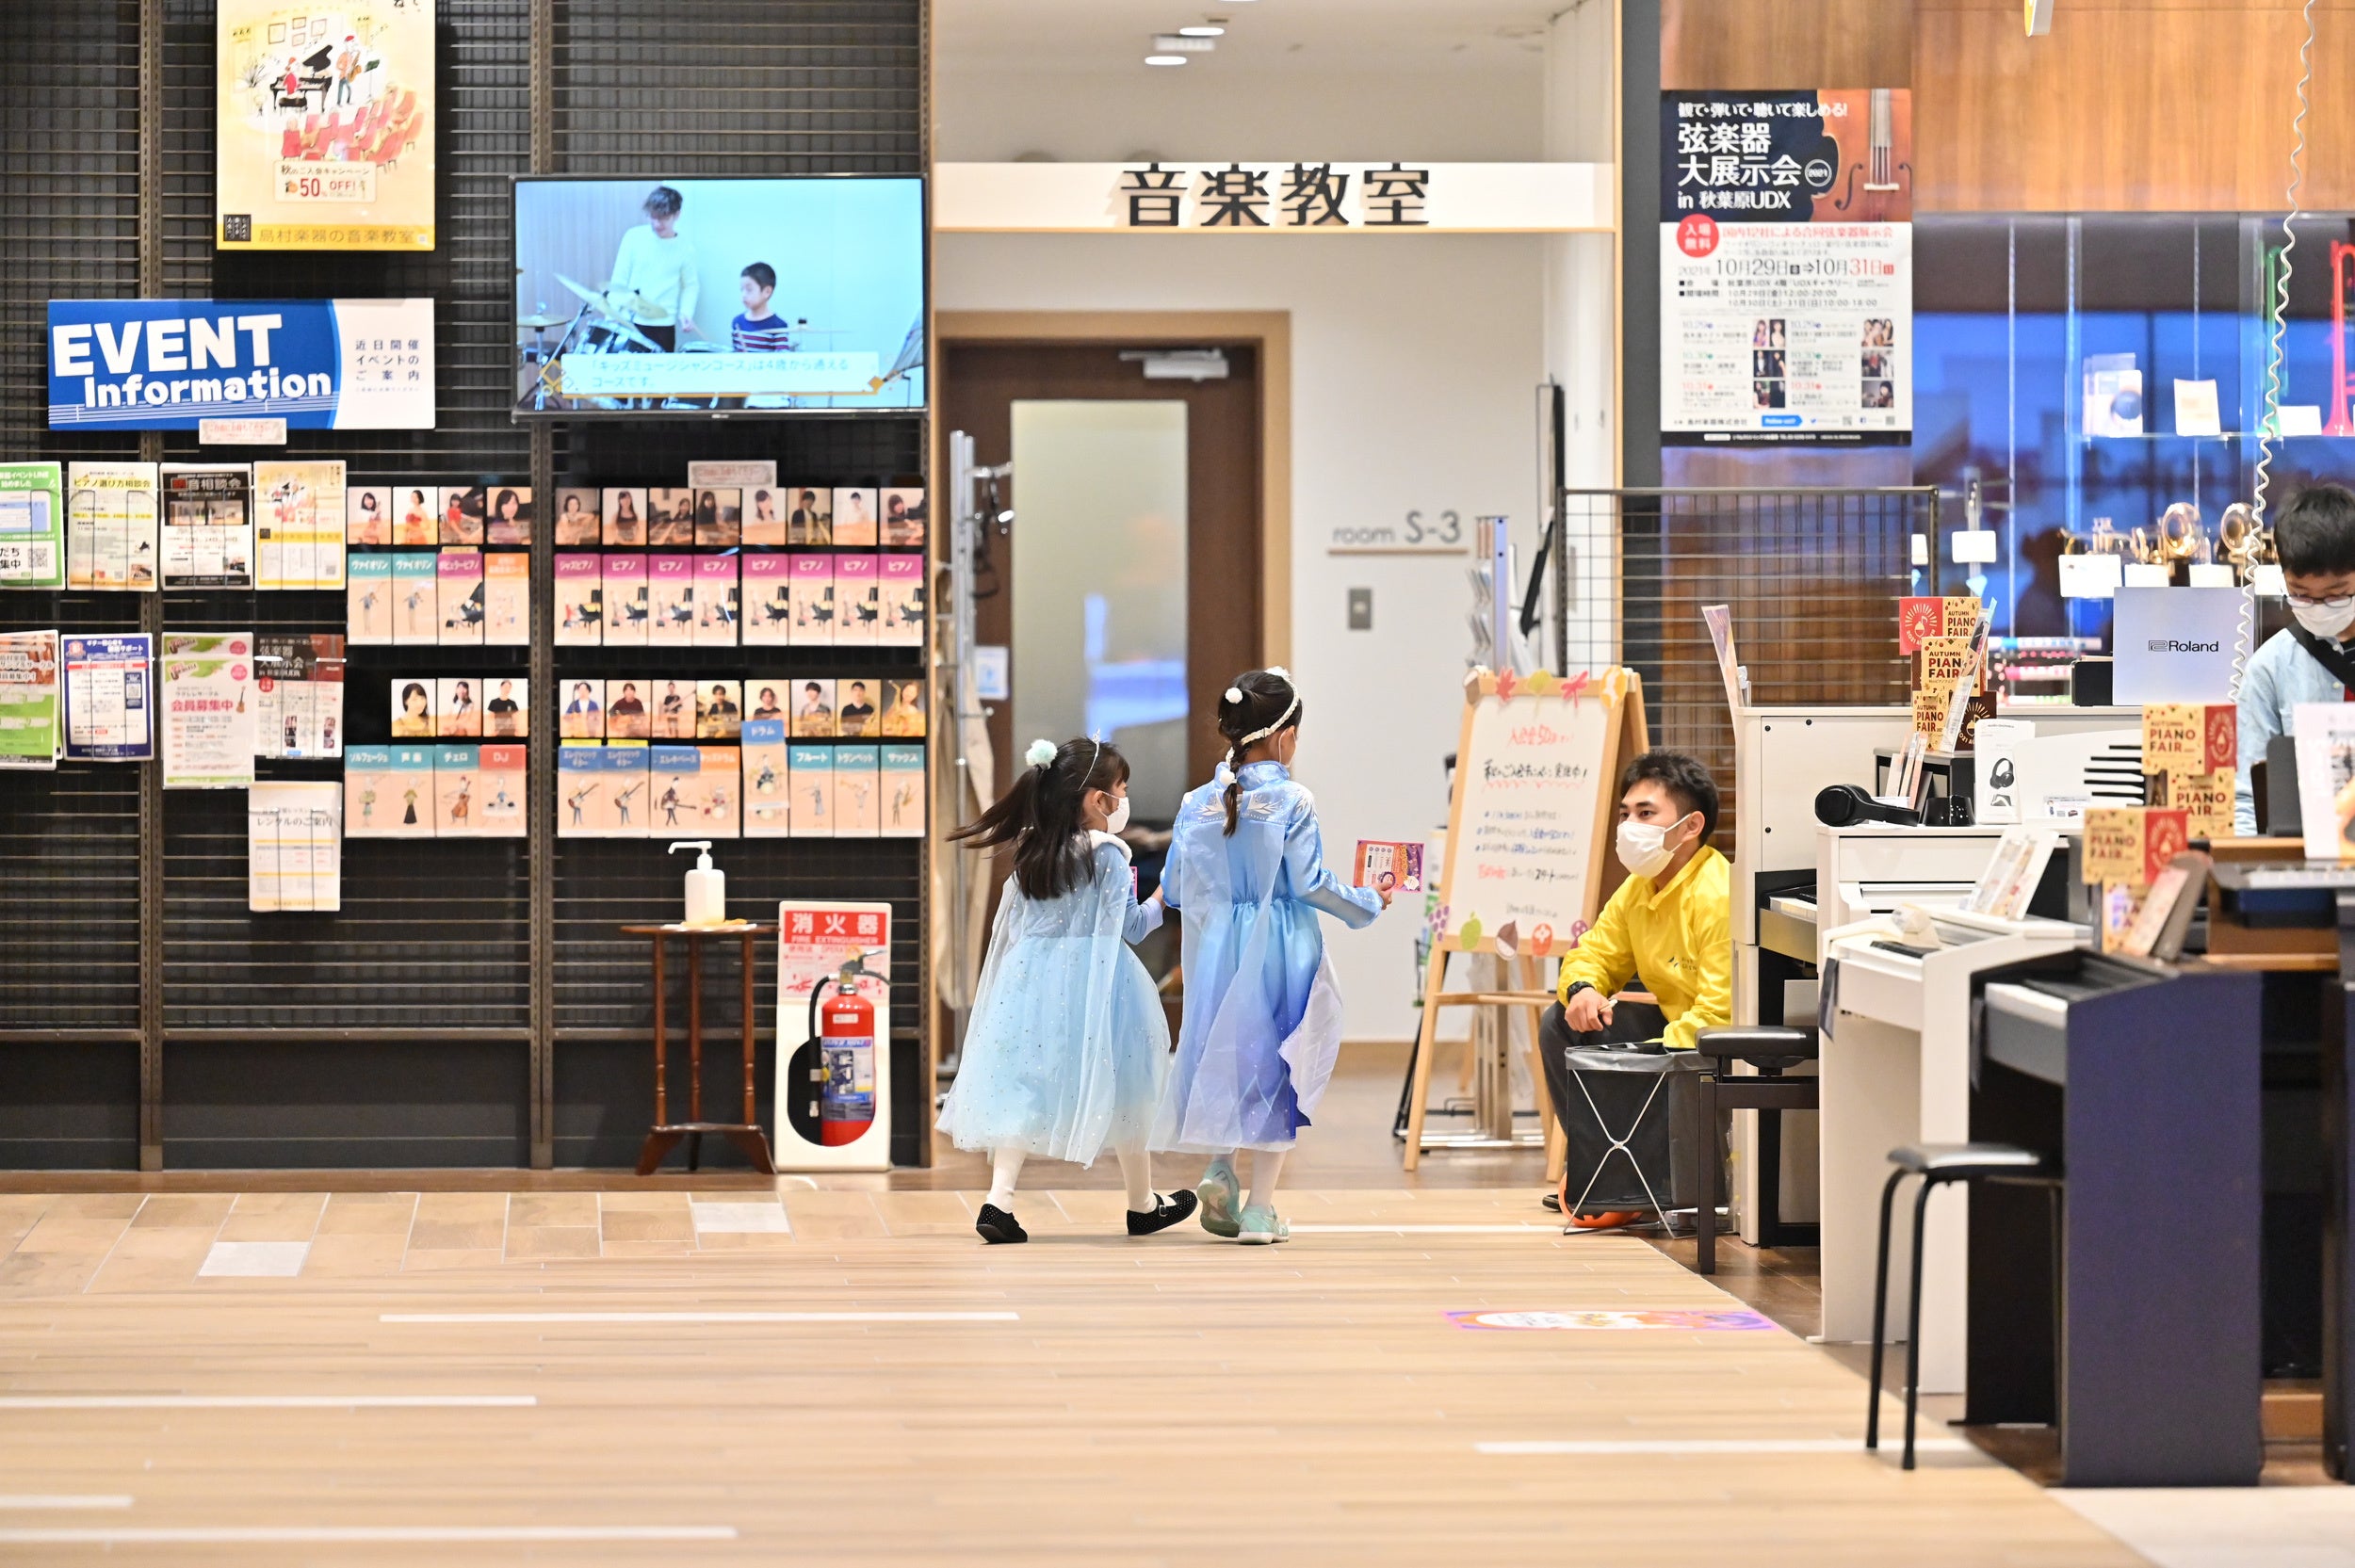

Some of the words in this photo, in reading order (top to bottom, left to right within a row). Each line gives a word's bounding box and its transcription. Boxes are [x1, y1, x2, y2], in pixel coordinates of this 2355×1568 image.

[1678, 122, 1771, 154] 弦楽器
[1678, 154, 1802, 186] 大展示会
[1808, 168, 1828, 178] 2021
[1119, 162, 1430, 227] 音楽教室
[1678, 191, 1695, 209] in
[1698, 191, 1792, 209] 秋葉原UDX
[258, 229, 414, 244] 島村楽器の音楽教室
[53, 314, 284, 378] EVENT
[355, 340, 419, 350] 近日開催
[356, 355, 419, 365] イベントの
[356, 370, 419, 381] ご案内
[83, 366, 333, 409] Information
[73, 477, 151, 488] ピアノ選び方相談会
[1333, 526, 1394, 544] room
[1405, 510, 1462, 543] S-3
[1948, 627, 1969, 637] FAIR
[2168, 640, 2219, 653] Roland
[1928, 657, 1962, 668] PIAN
[1928, 669, 1959, 678] FAIR
[171, 700, 234, 712] 会員募集中
[1916, 711, 1944, 721] PIANO
[1916, 722, 1937, 732] FAIR
[2150, 729, 2196, 740] PIANO
[2150, 741, 2182, 752] FAIR
[444, 752, 468, 763] チェロ
[493, 752, 509, 763] DJ
[796, 752, 828, 763] フルート
[887, 752, 918, 764] サックス
[2176, 793, 2227, 804] PIANO
[2090, 834, 2136, 847] PIANO
[791, 913, 879, 935] 消火器
